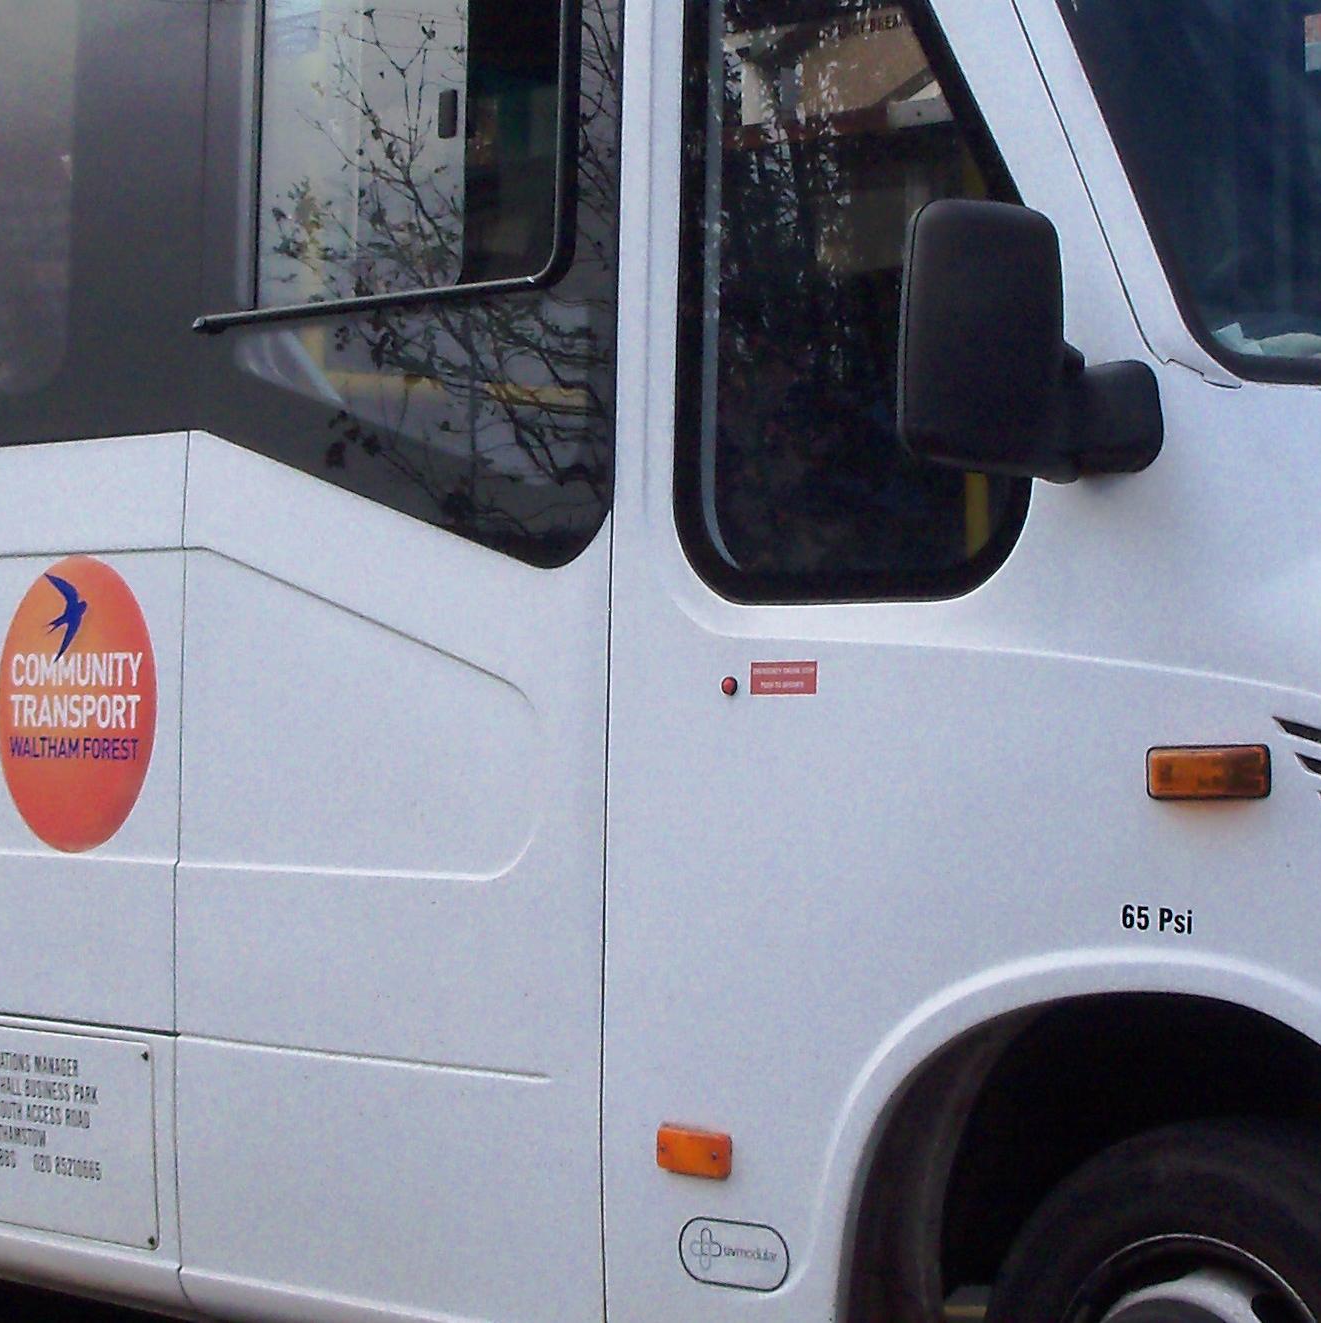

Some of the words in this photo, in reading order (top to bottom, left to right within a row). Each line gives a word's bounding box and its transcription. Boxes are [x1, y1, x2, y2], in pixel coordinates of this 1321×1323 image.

[10, 652, 143, 687] COMMUNITY
[10, 694, 141, 729] TRANSPORT
[9, 736, 79, 758] WALTHAM
[82, 738, 138, 761] FOREST
[1122, 904, 1150, 930] 65
[1159, 907, 1193, 935] Psi
[34, 1055, 79, 1078] MANAGER
[0, 1076, 22, 1096] HALL
[24, 1078, 71, 1102] BUSINESS
[73, 1084, 99, 1105] PARK
[27, 1104, 63, 1125] ACCESS
[65, 1108, 91, 1129] ROAD
